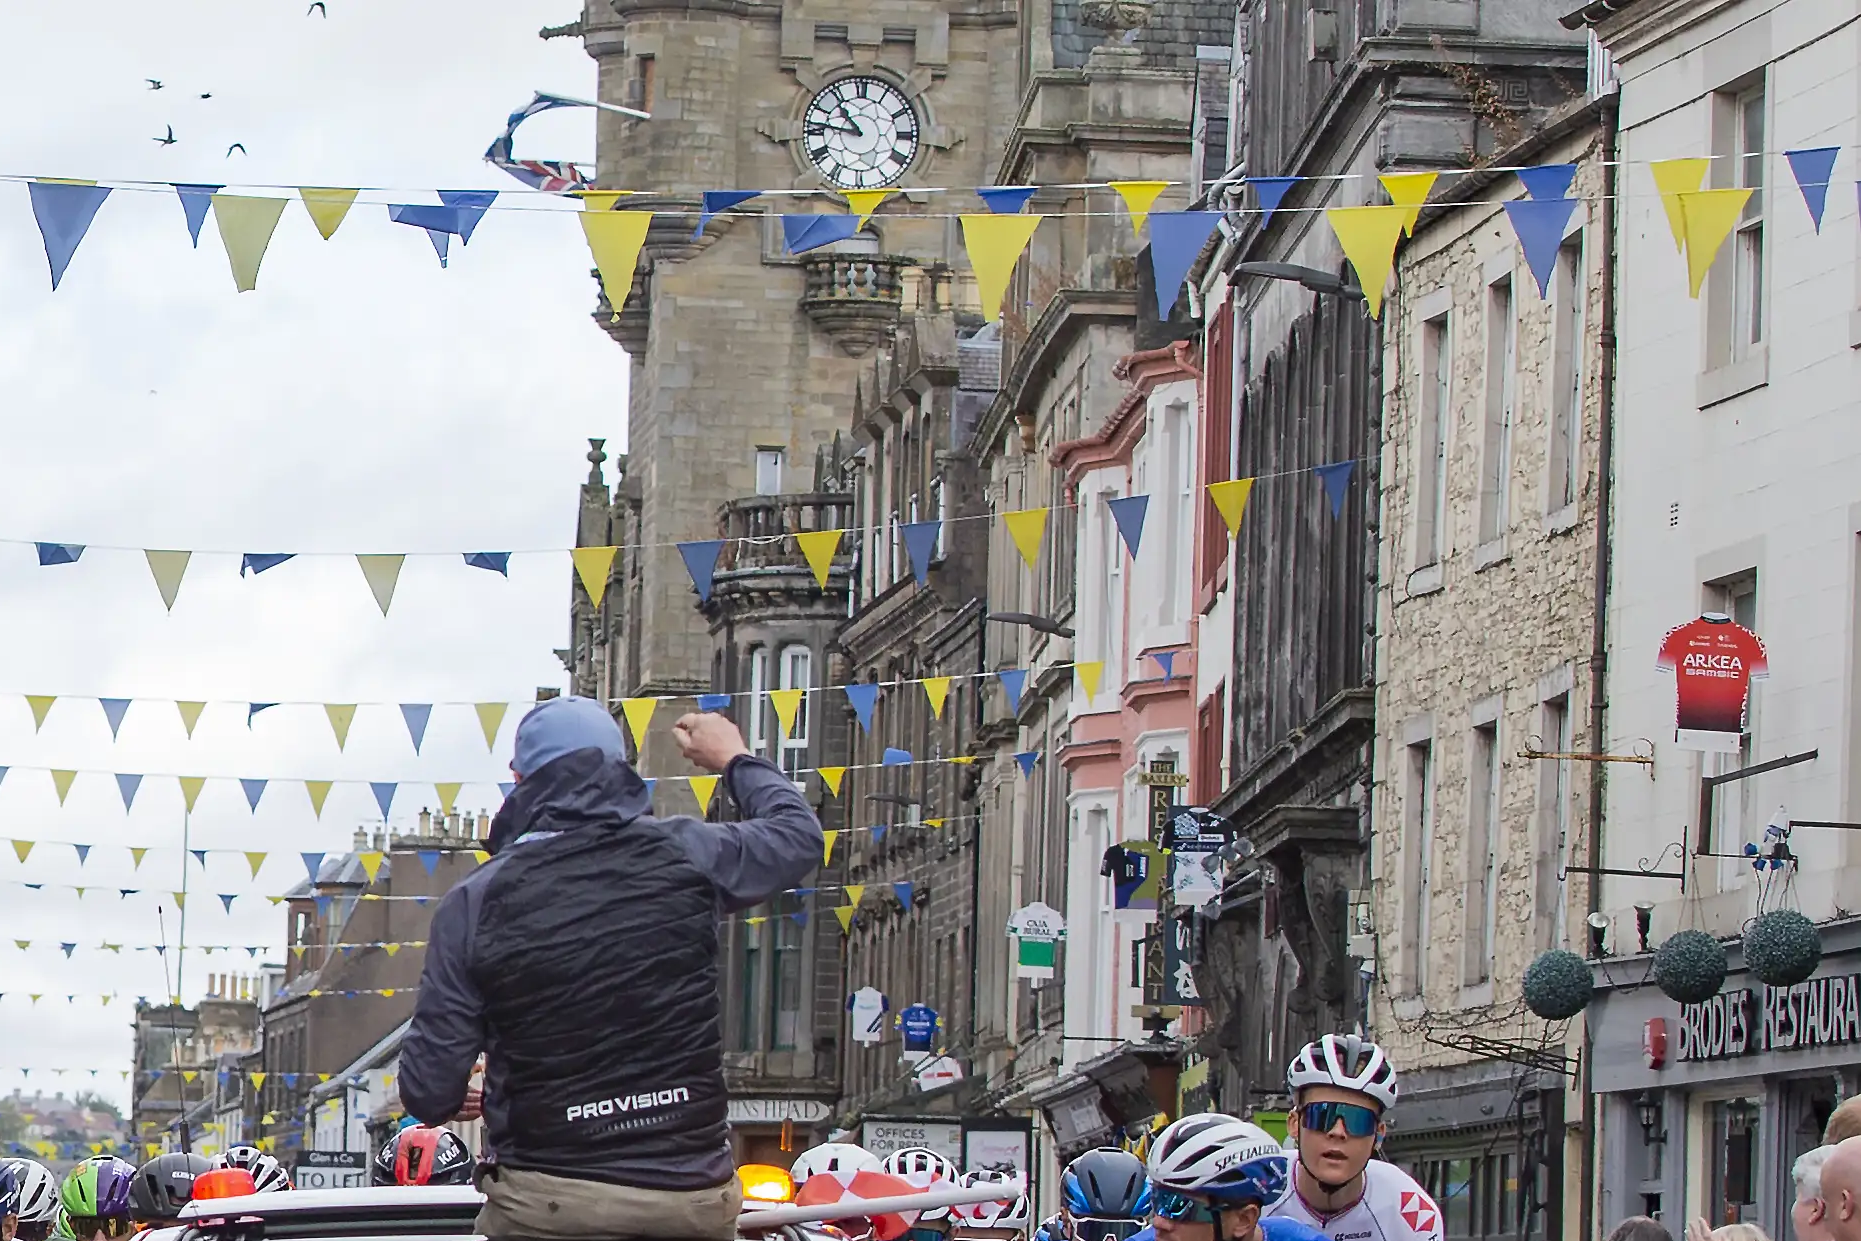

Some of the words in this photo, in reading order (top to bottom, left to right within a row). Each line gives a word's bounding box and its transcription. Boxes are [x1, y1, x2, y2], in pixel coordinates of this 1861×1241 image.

[1683, 653, 1743, 670] ARKEA
[1153, 762, 1173, 773] THE
[1140, 774, 1183, 785] BAKERY
[1676, 988, 1748, 1060] BRODIES
[566, 1087, 690, 1122] PROVISION
[764, 1099, 819, 1118] HEAD
[874, 1127, 925, 1140] OFFICES
[870, 1138, 894, 1150] FOR
[339, 1153, 354, 1163] Co
[299, 1172, 325, 1188] TO
[332, 1172, 366, 1188] LET
